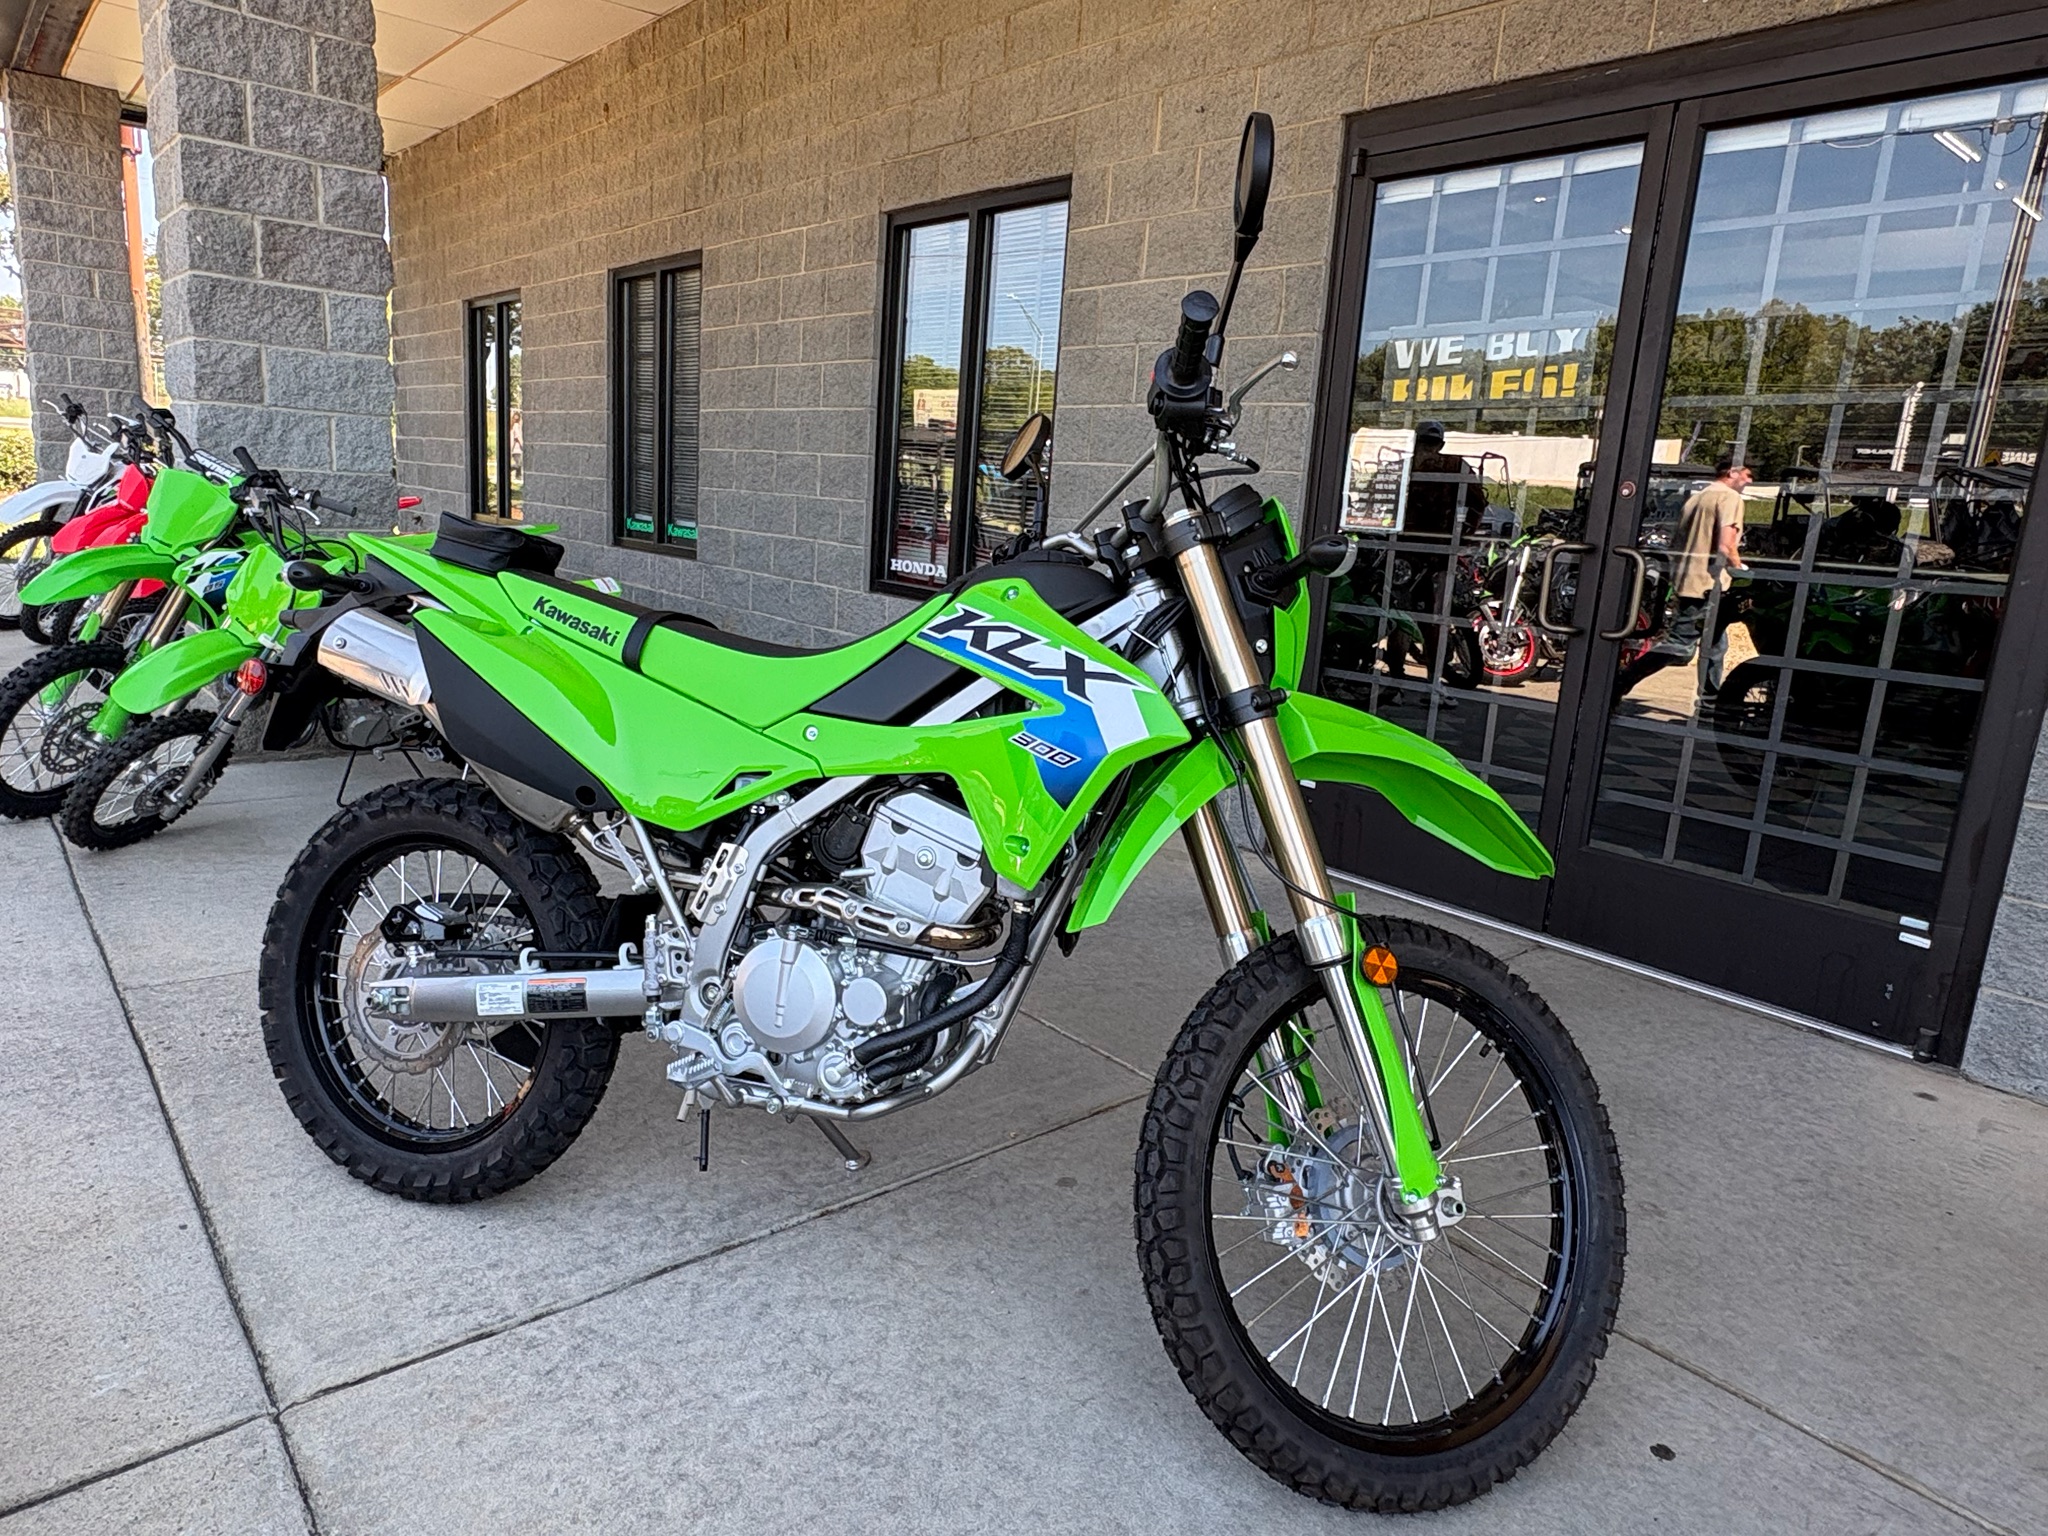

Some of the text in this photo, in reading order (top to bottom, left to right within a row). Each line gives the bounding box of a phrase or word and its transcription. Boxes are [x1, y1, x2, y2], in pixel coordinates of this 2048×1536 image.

[1395, 334, 1465, 369] WE
[890, 558, 948, 579] HONDA
[532, 596, 621, 647] Kawasaki
[924, 605, 1148, 703] KLX
[1010, 731, 1080, 767] 300
